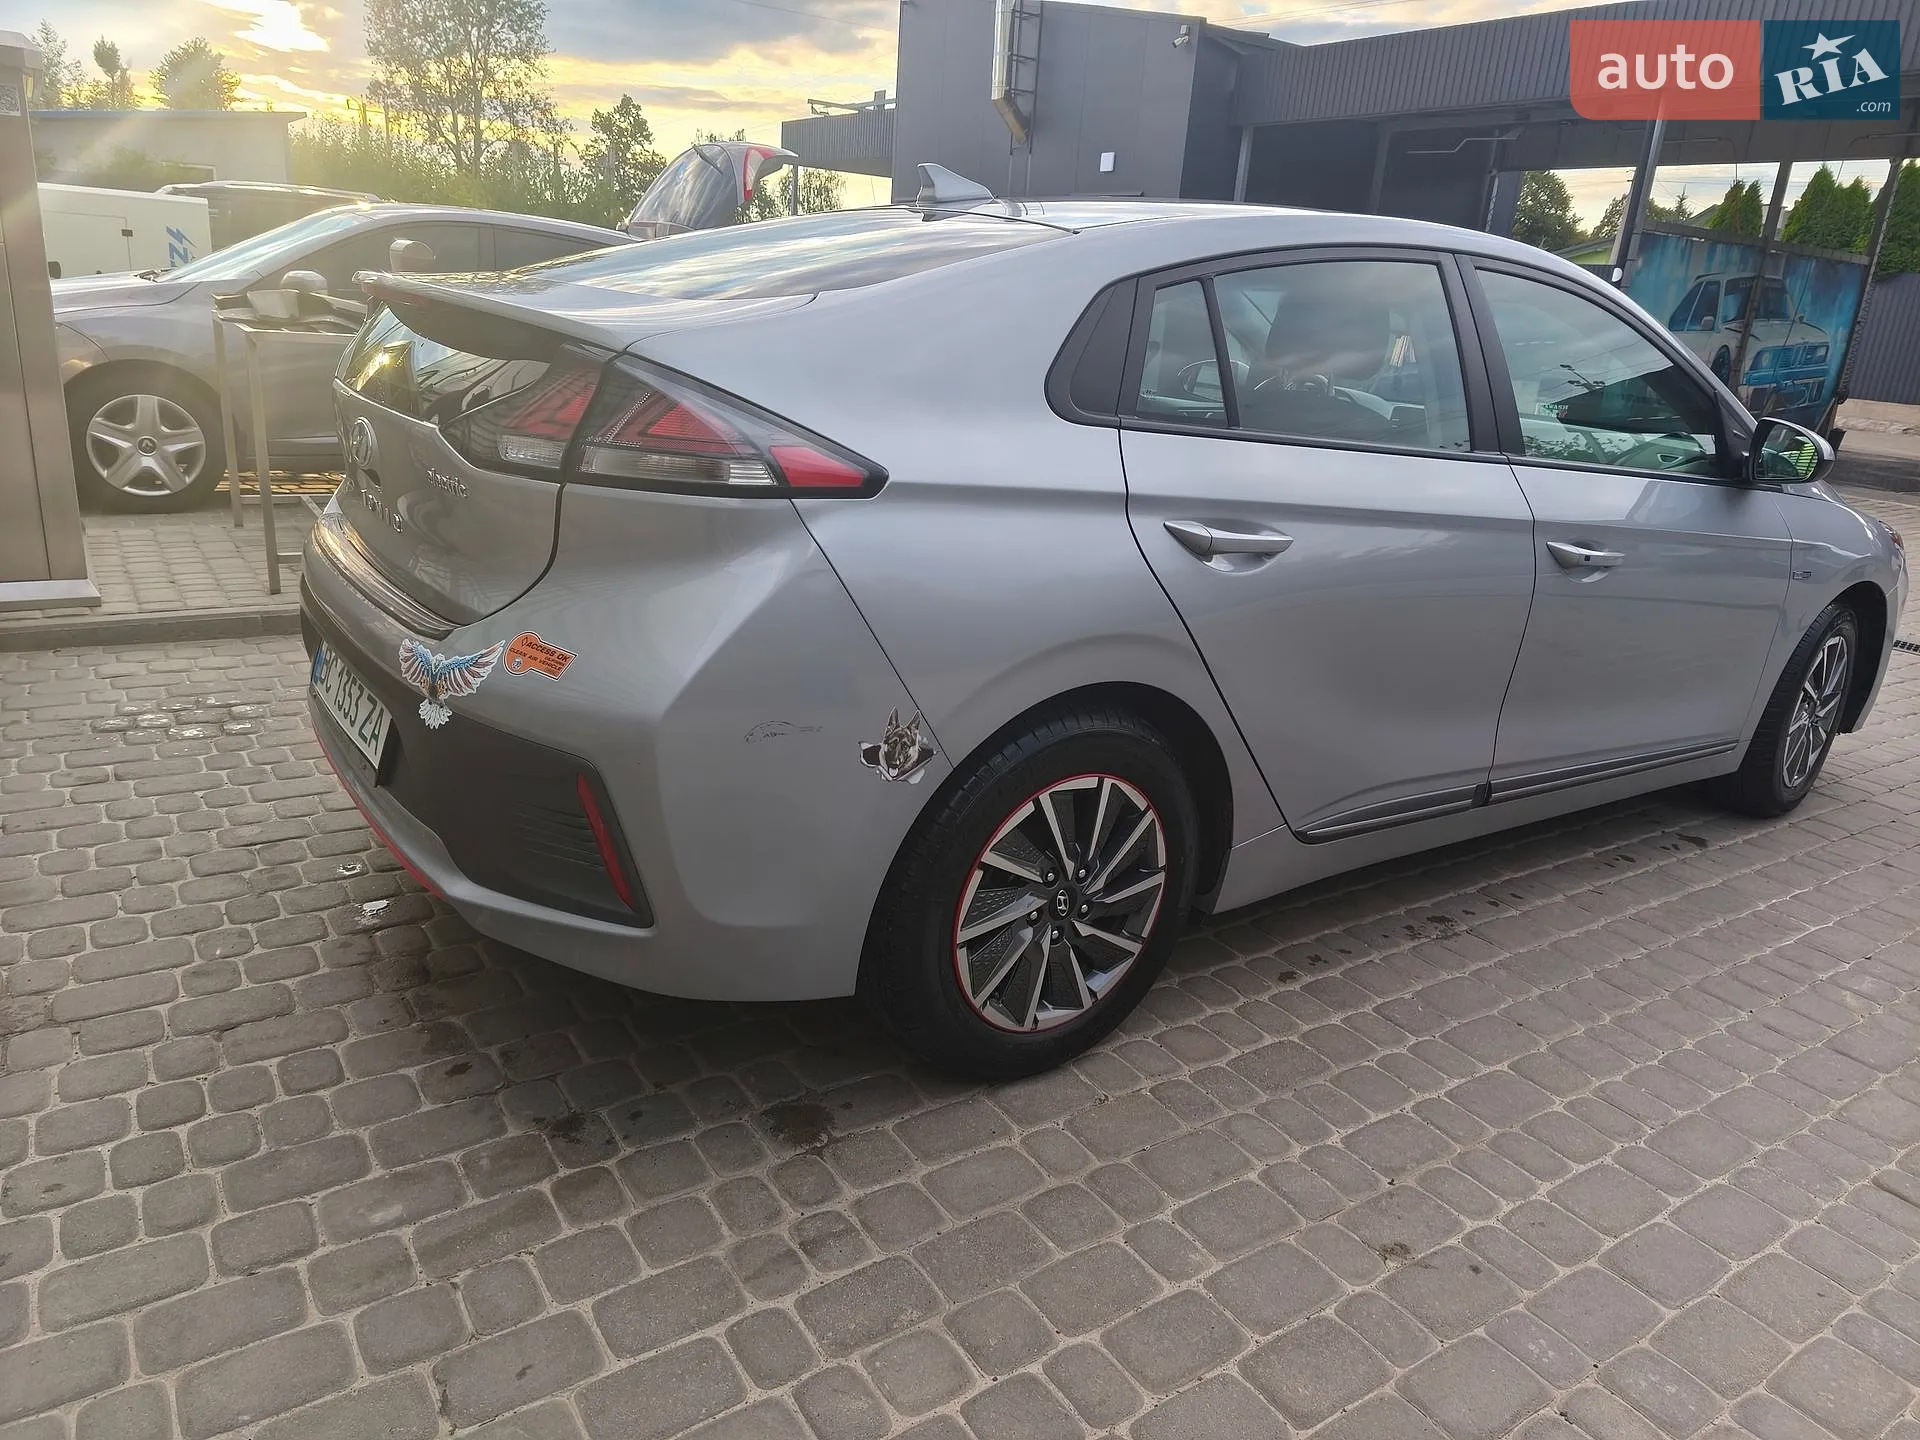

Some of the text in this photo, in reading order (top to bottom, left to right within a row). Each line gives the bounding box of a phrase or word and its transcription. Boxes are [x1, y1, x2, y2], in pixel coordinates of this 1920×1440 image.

[527, 641, 555, 656] ACCESS
[557, 653, 570, 662] OK
[528, 654, 538, 662] AIR
[539, 658, 562, 672] VEHICLE
